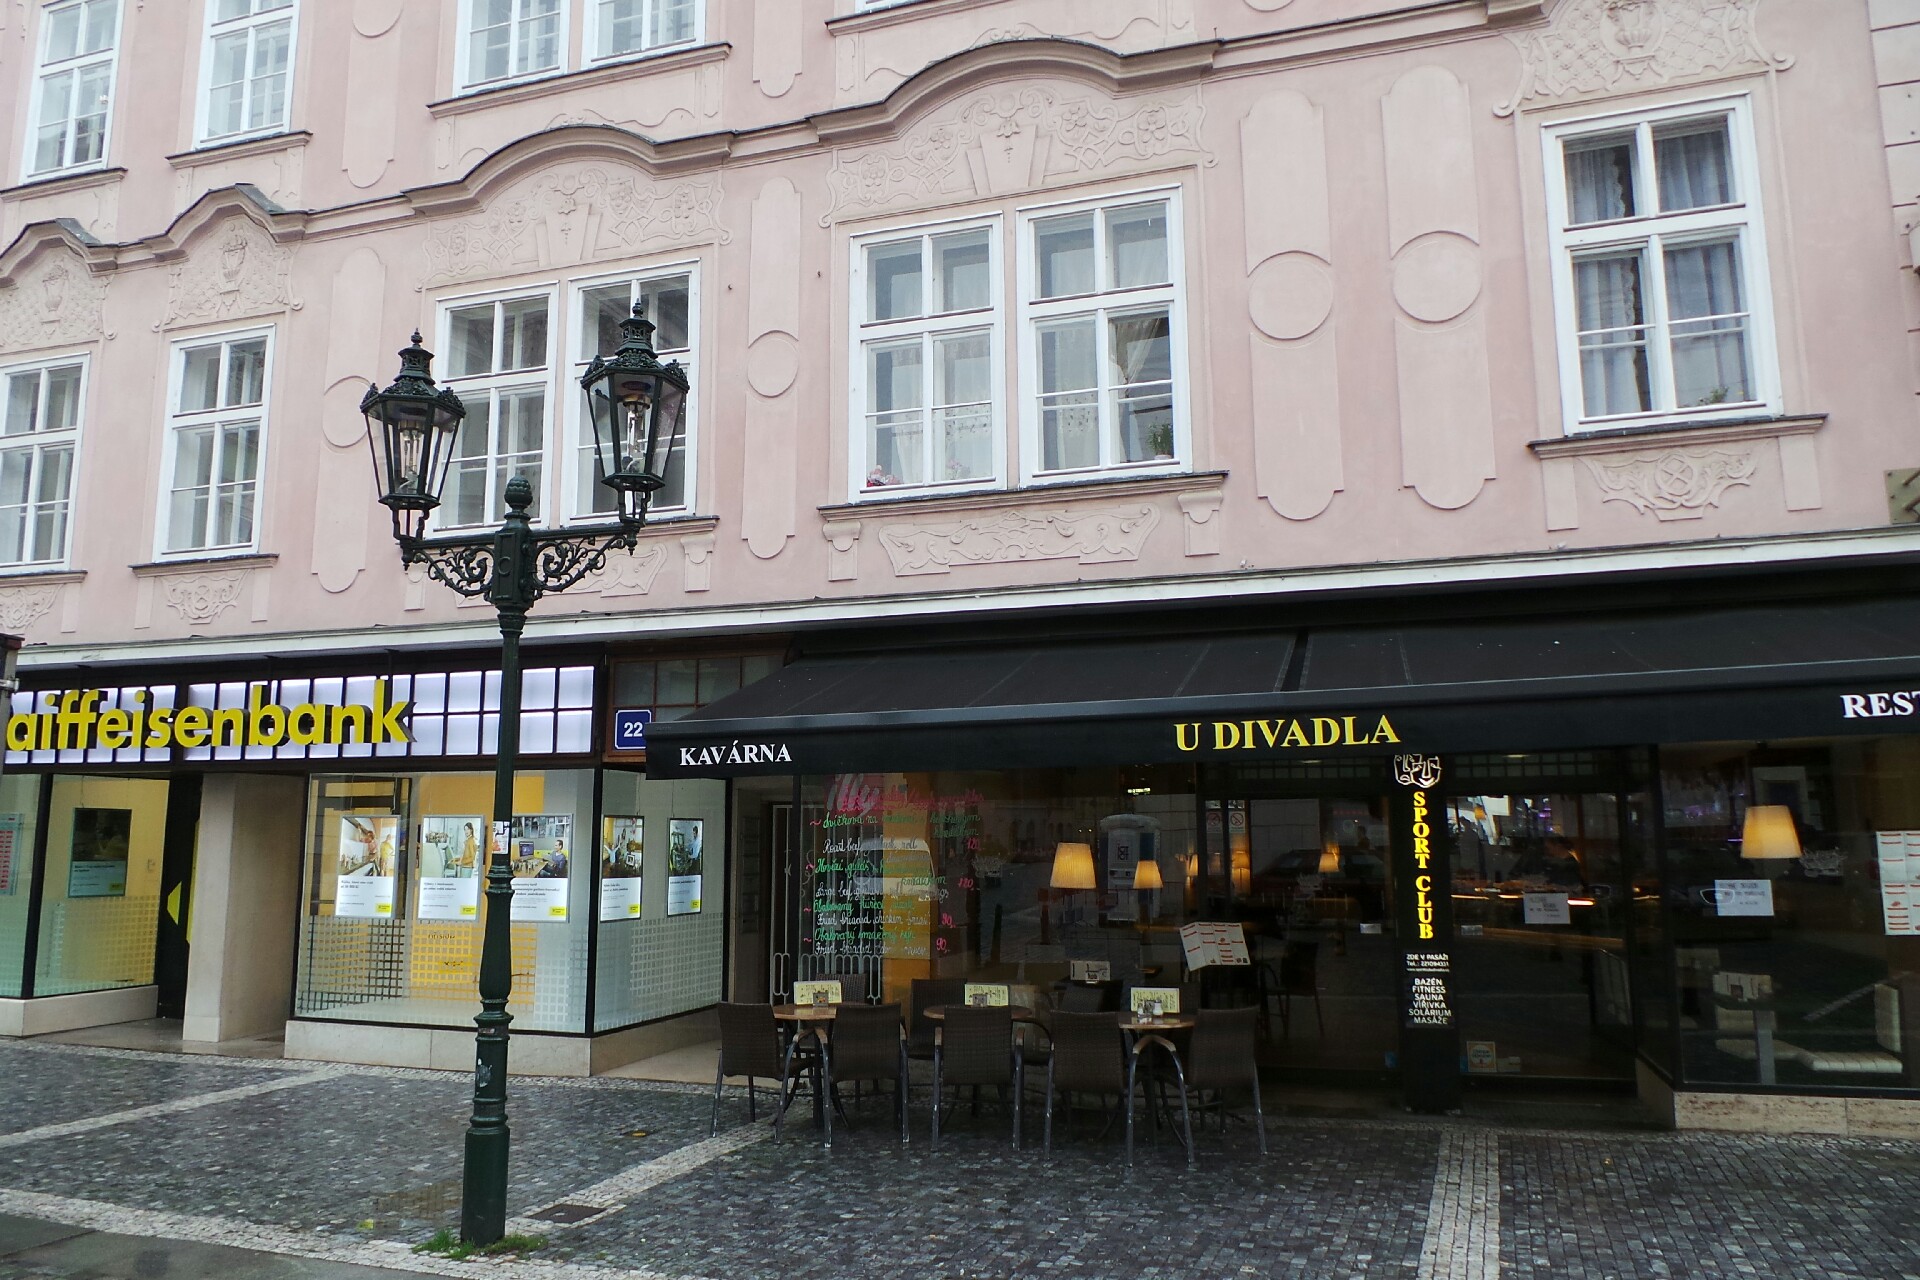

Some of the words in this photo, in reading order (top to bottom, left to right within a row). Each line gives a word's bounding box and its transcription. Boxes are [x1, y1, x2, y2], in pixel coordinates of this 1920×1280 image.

[623, 722, 643, 738] 22
[1174, 722, 1202, 751] U
[1211, 714, 1401, 750] DIVADLA
[679, 740, 792, 766] KAVÁRNA
[1413, 791, 1430, 868] SPORT
[1415, 875, 1434, 939] CLUB
[1414, 978, 1443, 986] BAZÉN
[1412, 986, 1446, 994] FITNESS
[1414, 993, 1444, 1001] SAUNA
[1408, 1007, 1452, 1017] SOLÁRIUM
[1413, 1016, 1448, 1025] MASÁŽE
